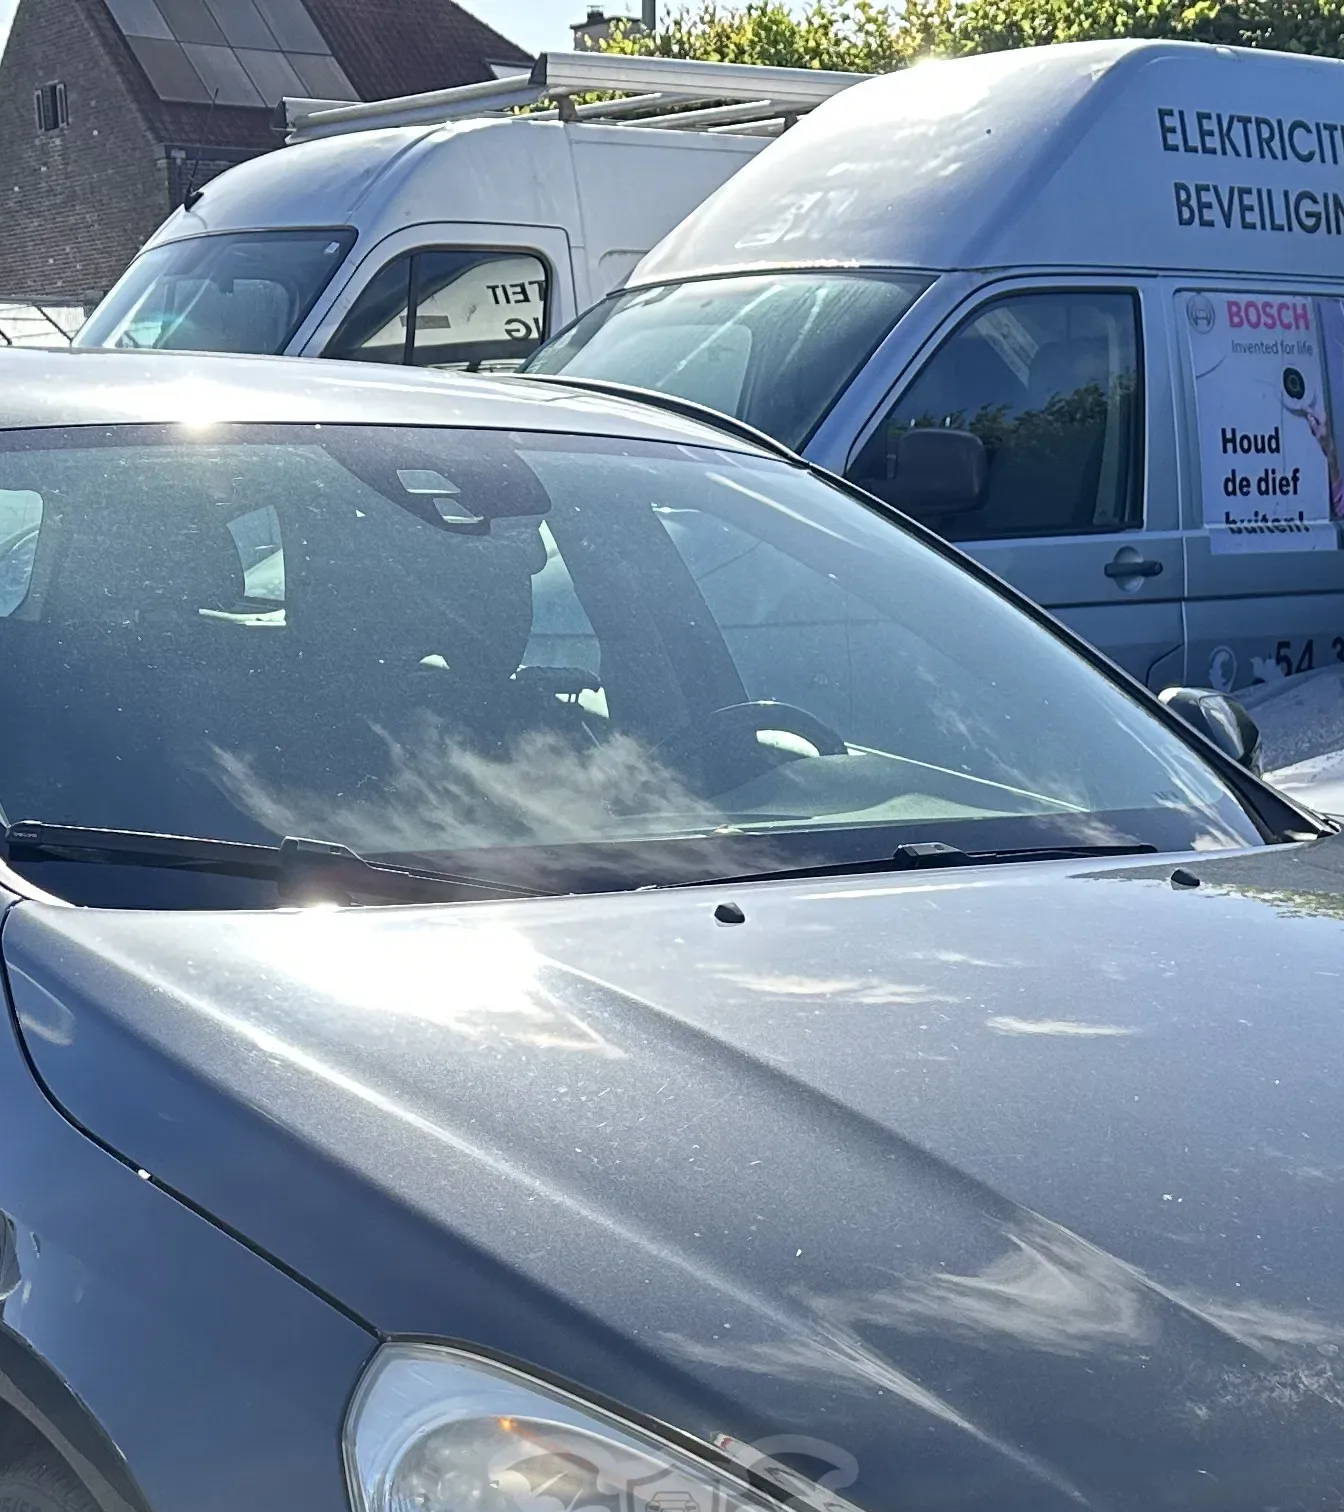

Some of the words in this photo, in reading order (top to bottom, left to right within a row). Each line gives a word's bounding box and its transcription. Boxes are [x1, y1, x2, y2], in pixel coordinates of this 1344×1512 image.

[1226, 300, 1311, 331] BOSCH
[1231, 339, 1279, 355] Invented
[1280, 340, 1296, 355] for
[1297, 341, 1313, 356] life
[1221, 426, 1280, 454] Houd
[1223, 468, 1251, 497] de
[1257, 467, 1300, 496] dief
